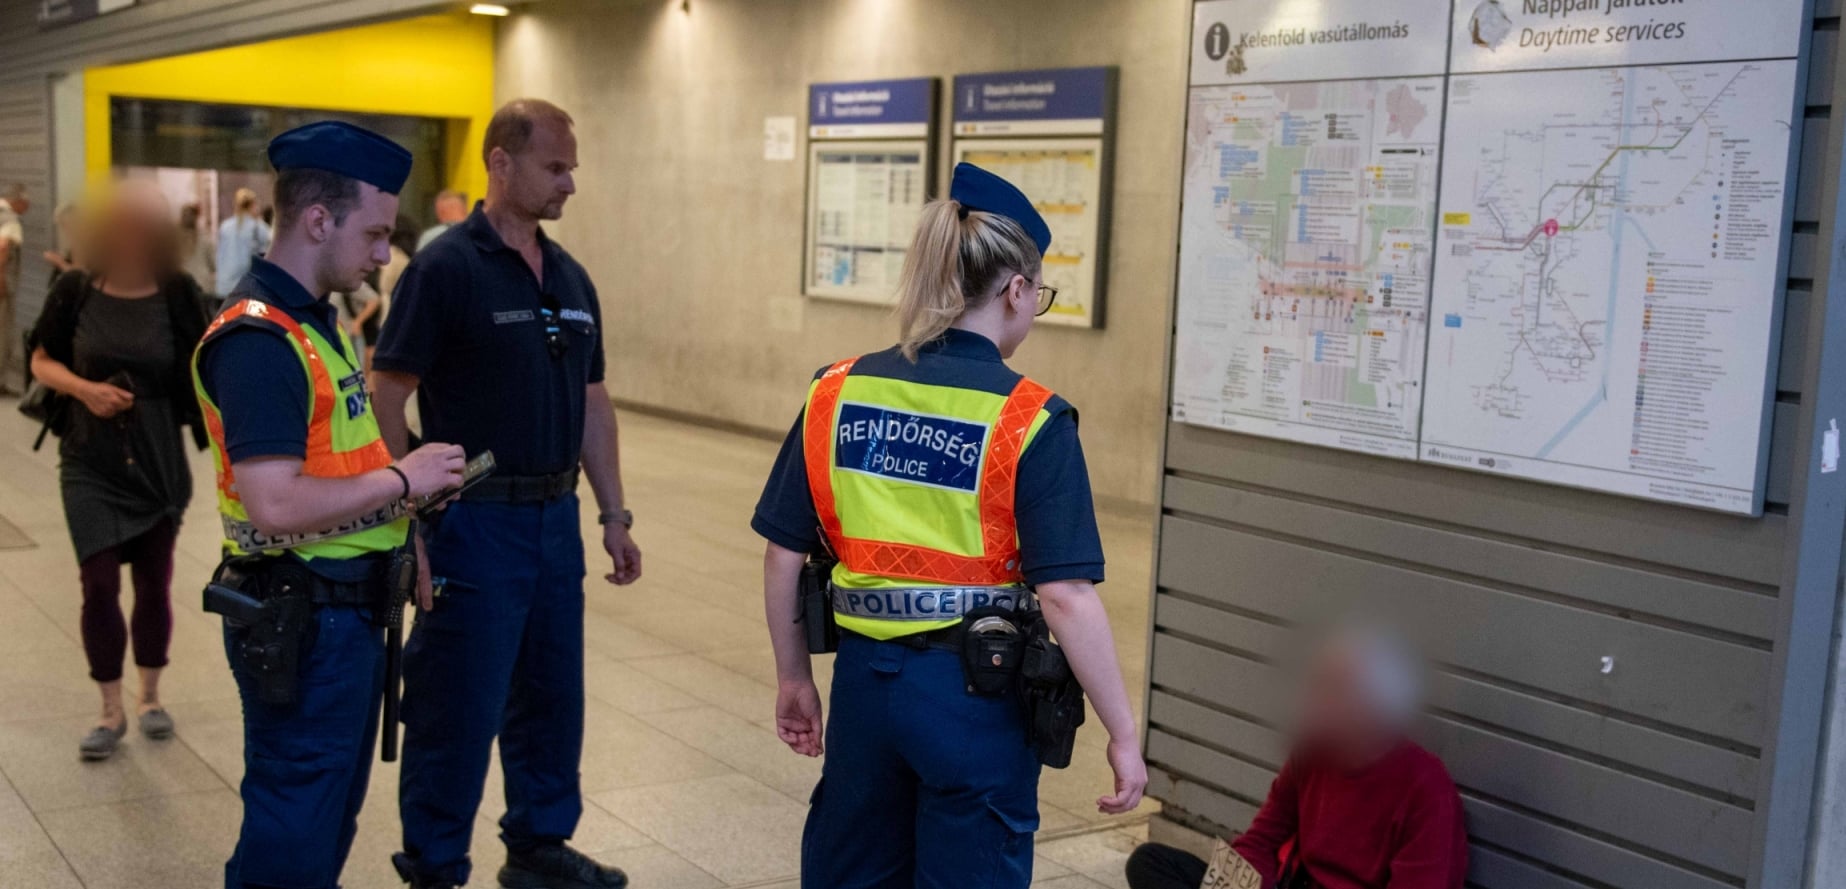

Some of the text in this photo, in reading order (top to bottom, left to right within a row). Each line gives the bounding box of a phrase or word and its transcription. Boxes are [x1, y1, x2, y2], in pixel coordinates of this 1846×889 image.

[1239, 20, 1409, 48] Kelenföld vasútállomás
[1519, 19, 1686, 52] Daytime services
[839, 416, 979, 468] RENDŐRSÉG
[871, 453, 929, 477] POLICE
[847, 591, 956, 615] POLICE
